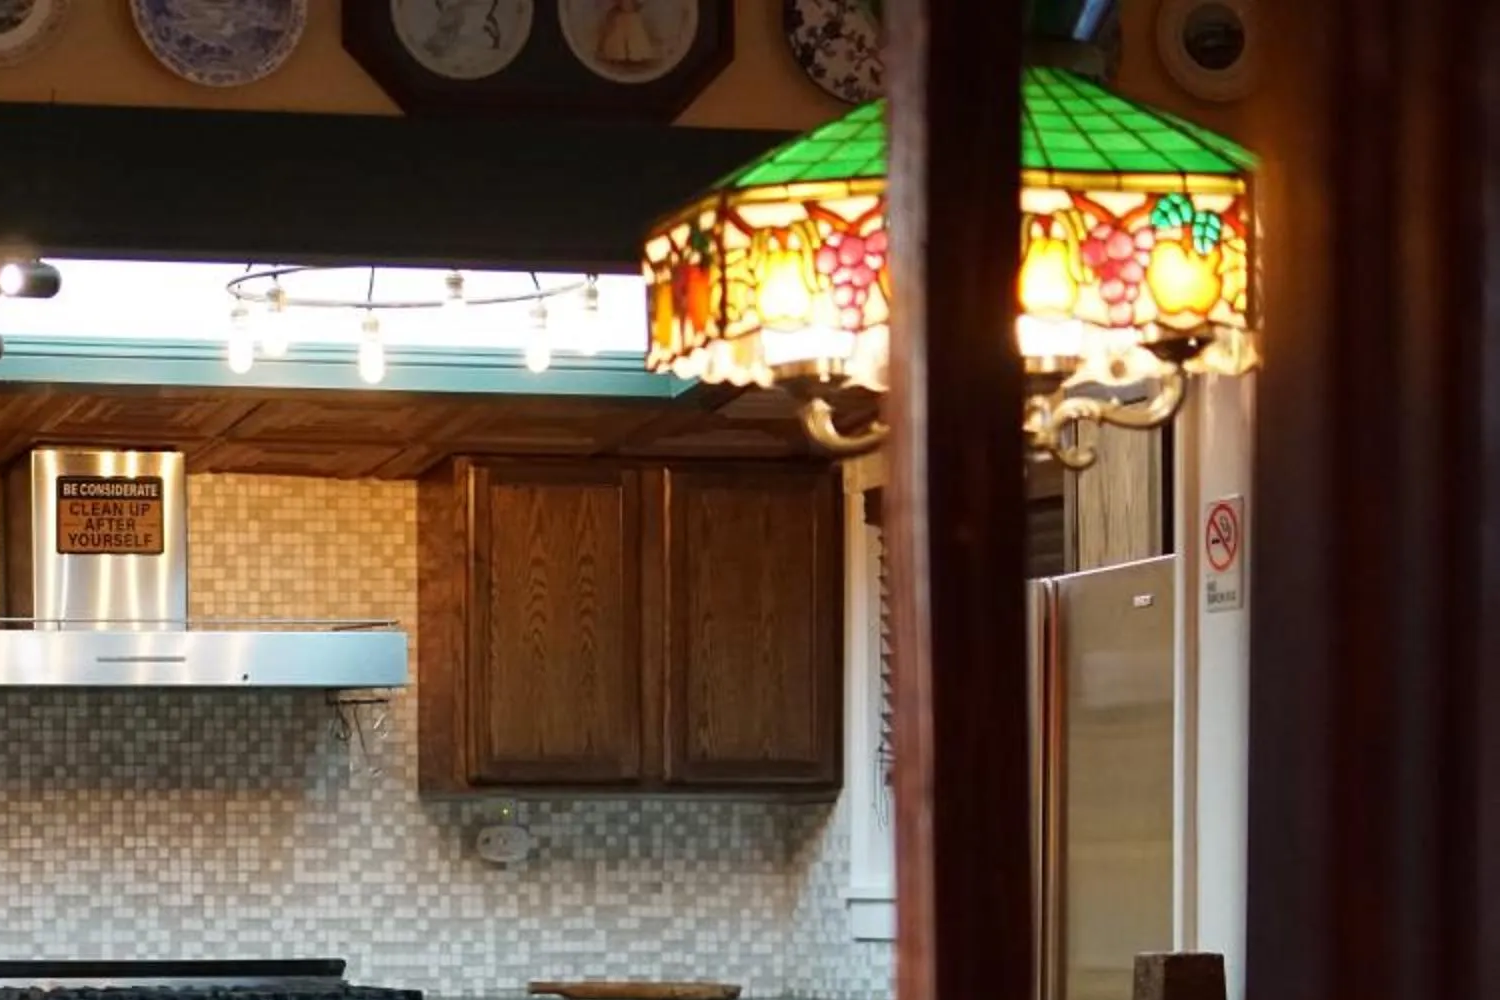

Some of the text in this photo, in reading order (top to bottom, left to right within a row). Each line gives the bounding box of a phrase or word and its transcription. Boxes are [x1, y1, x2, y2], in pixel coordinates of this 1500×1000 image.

[63, 483, 158, 497] BE CONSIDERATE
[69, 502, 151, 516] CLEAN UP
[85, 518, 136, 532] AFTER
[68, 533, 153, 548] YOURSELF
